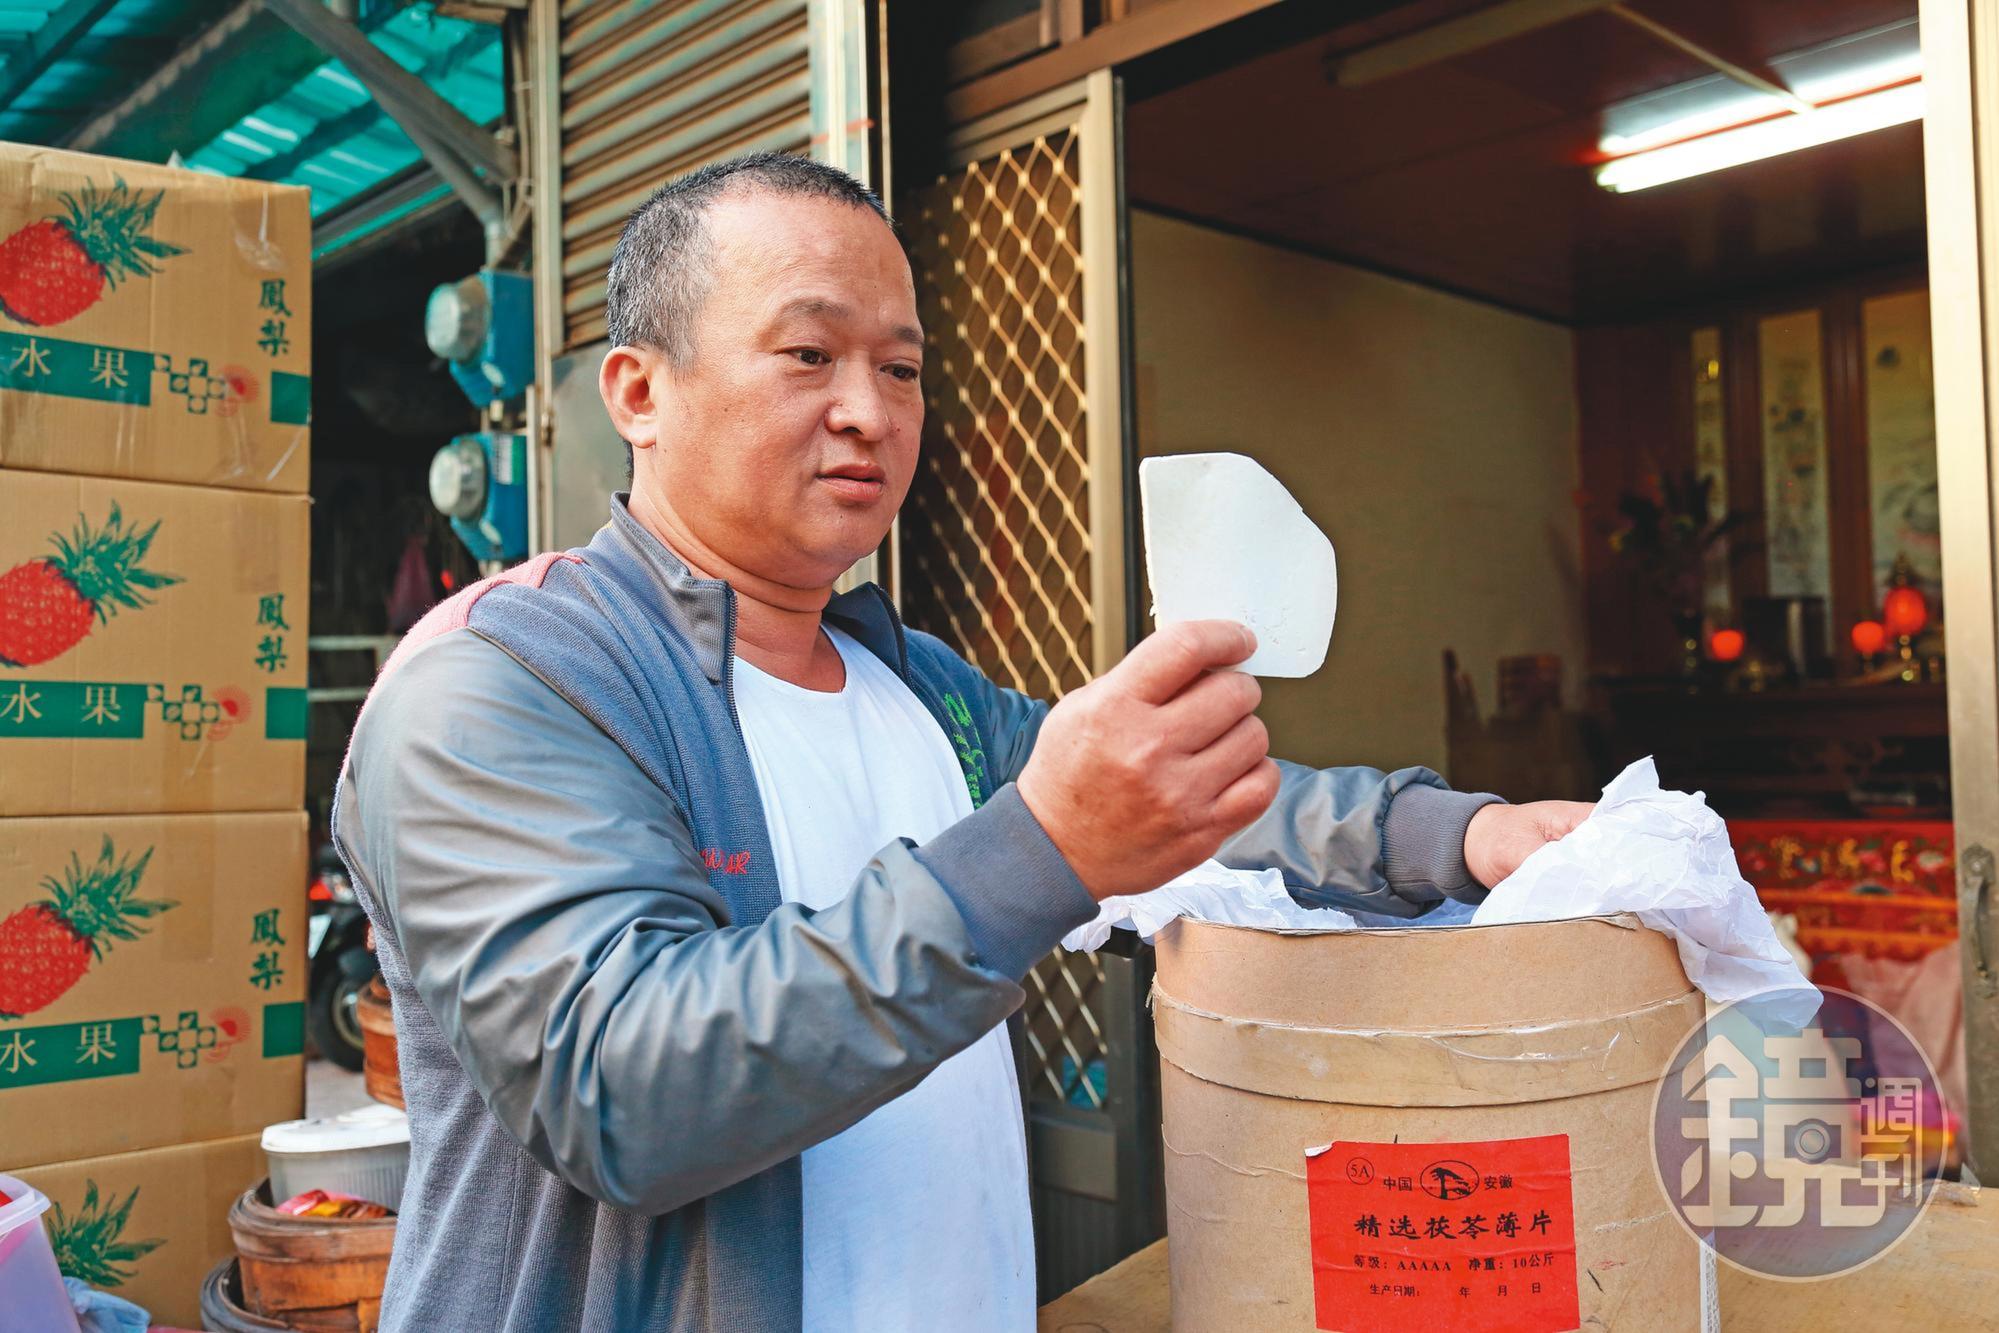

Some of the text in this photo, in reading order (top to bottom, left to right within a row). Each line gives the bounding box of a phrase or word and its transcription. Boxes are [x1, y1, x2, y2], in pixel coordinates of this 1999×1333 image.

[257, 278, 293, 357] 鳳梨
[10, 338, 130, 390] 水果
[254, 592, 291, 673] 鳳梨
[1, 683, 121, 725] 水果
[249, 908, 287, 991] 鳳梨
[0, 1022, 117, 1074] 水果
[1349, 1163, 1371, 1179] 5A
[1383, 1175, 1513, 1192] 中国 安徽
[1353, 1209, 1553, 1241] 精选茯苓薄片
[1397, 1260, 1452, 1272] AAAAA
[1513, 1253, 1554, 1269] 10公斤
